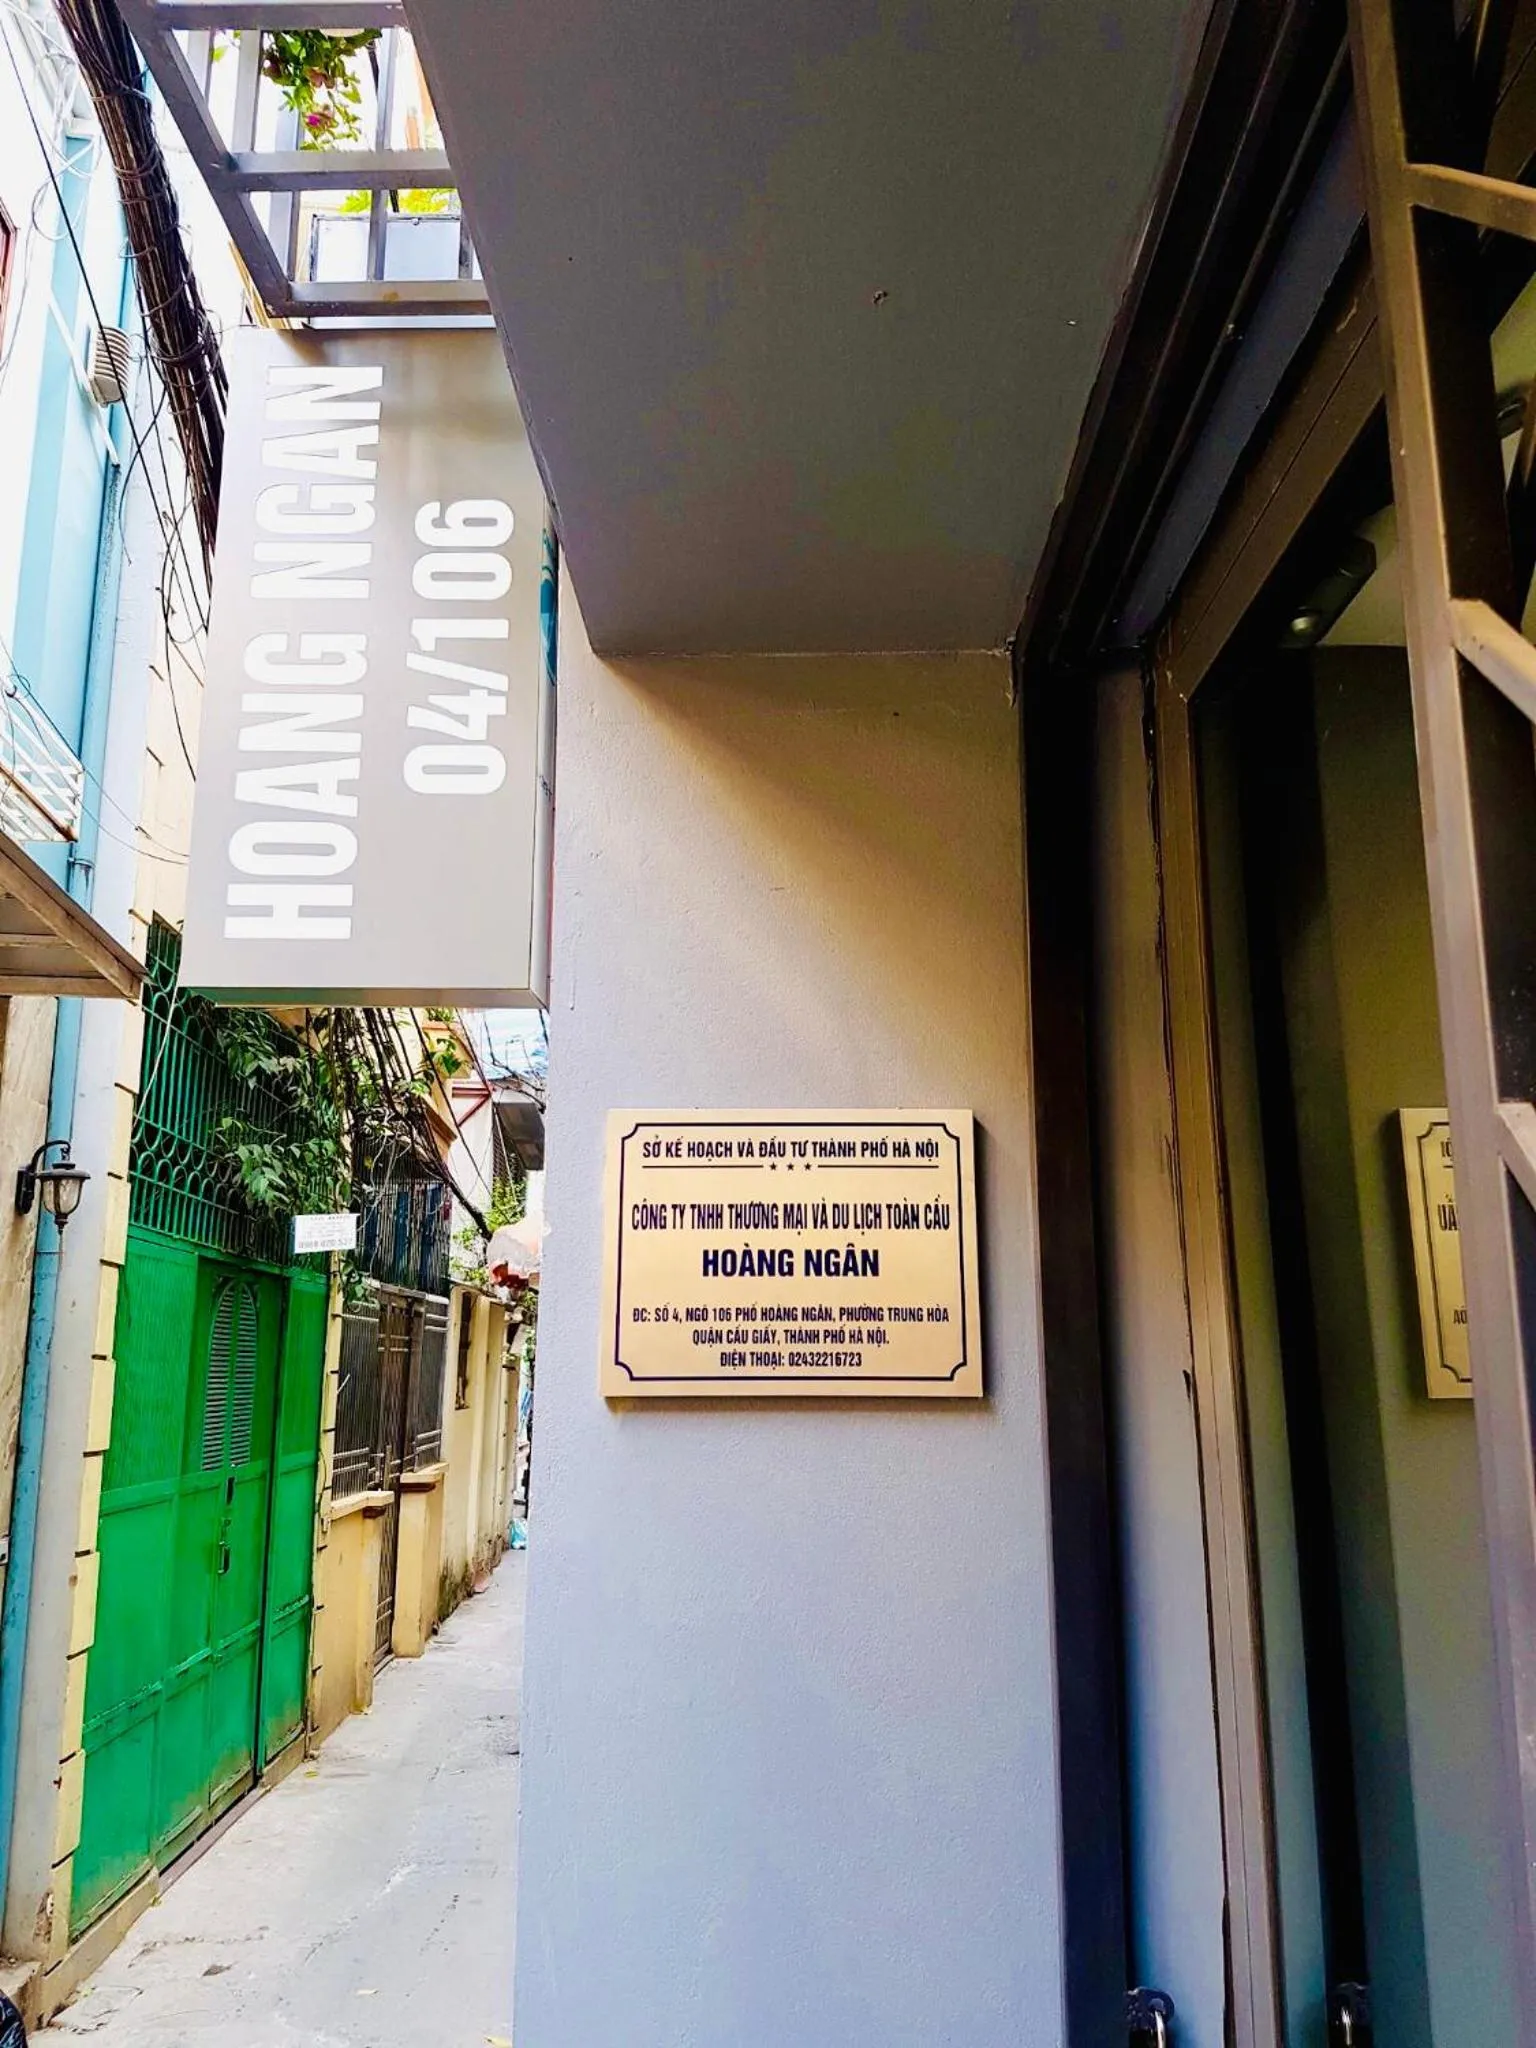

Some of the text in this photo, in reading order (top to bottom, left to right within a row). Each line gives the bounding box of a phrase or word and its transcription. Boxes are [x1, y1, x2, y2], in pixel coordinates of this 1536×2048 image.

[223, 364, 384, 940] HOANG NGAN
[403, 498, 515, 796] 04/106
[643, 1135, 661, 1158] SỞ
[666, 1136, 683, 1158] KẾ
[688, 1141, 732, 1162] HOẠCH
[738, 1138, 754, 1158] VÀ
[791, 1140, 808, 1158] TƯ
[812, 1138, 856, 1158] THÀNH
[861, 1136, 888, 1158] PHỐ
[893, 1138, 910, 1158] HÀ
[915, 1138, 939, 1162] NỘI
[632, 1194, 950, 1236] CÔNG TY TNHH THƯƠNG MẠI VÀ DU LỊCH TOÀN CẦU
[703, 1242, 879, 1277] HOÀNG NGÂN
[633, 1307, 651, 1323] ĐC:
[654, 1302, 670, 1323] SỐ
[672, 1307, 682, 1325] 4,
[686, 1304, 708, 1323] NGÕ
[712, 1307, 732, 1322] 106
[735, 1302, 757, 1322] PHỐ
[761, 1304, 798, 1322] HOÀNG
[839, 1303, 884, 1322] PHƯỜNG
[888, 1307, 924, 1322] TRUNG
[927, 1304, 949, 1322] HÒA
[692, 1326, 723, 1348] QUẬN
[752, 1324, 781, 1346] GIẤY,
[784, 1326, 820, 1344] THÀNH
[823, 1324, 846, 1344] PHỐ
[849, 1326, 863, 1344] HÀ
[867, 1326, 890, 1348] NỘI.
[720, 1349, 862, 1370] ĐIỆN THOẠI: 02432216723
